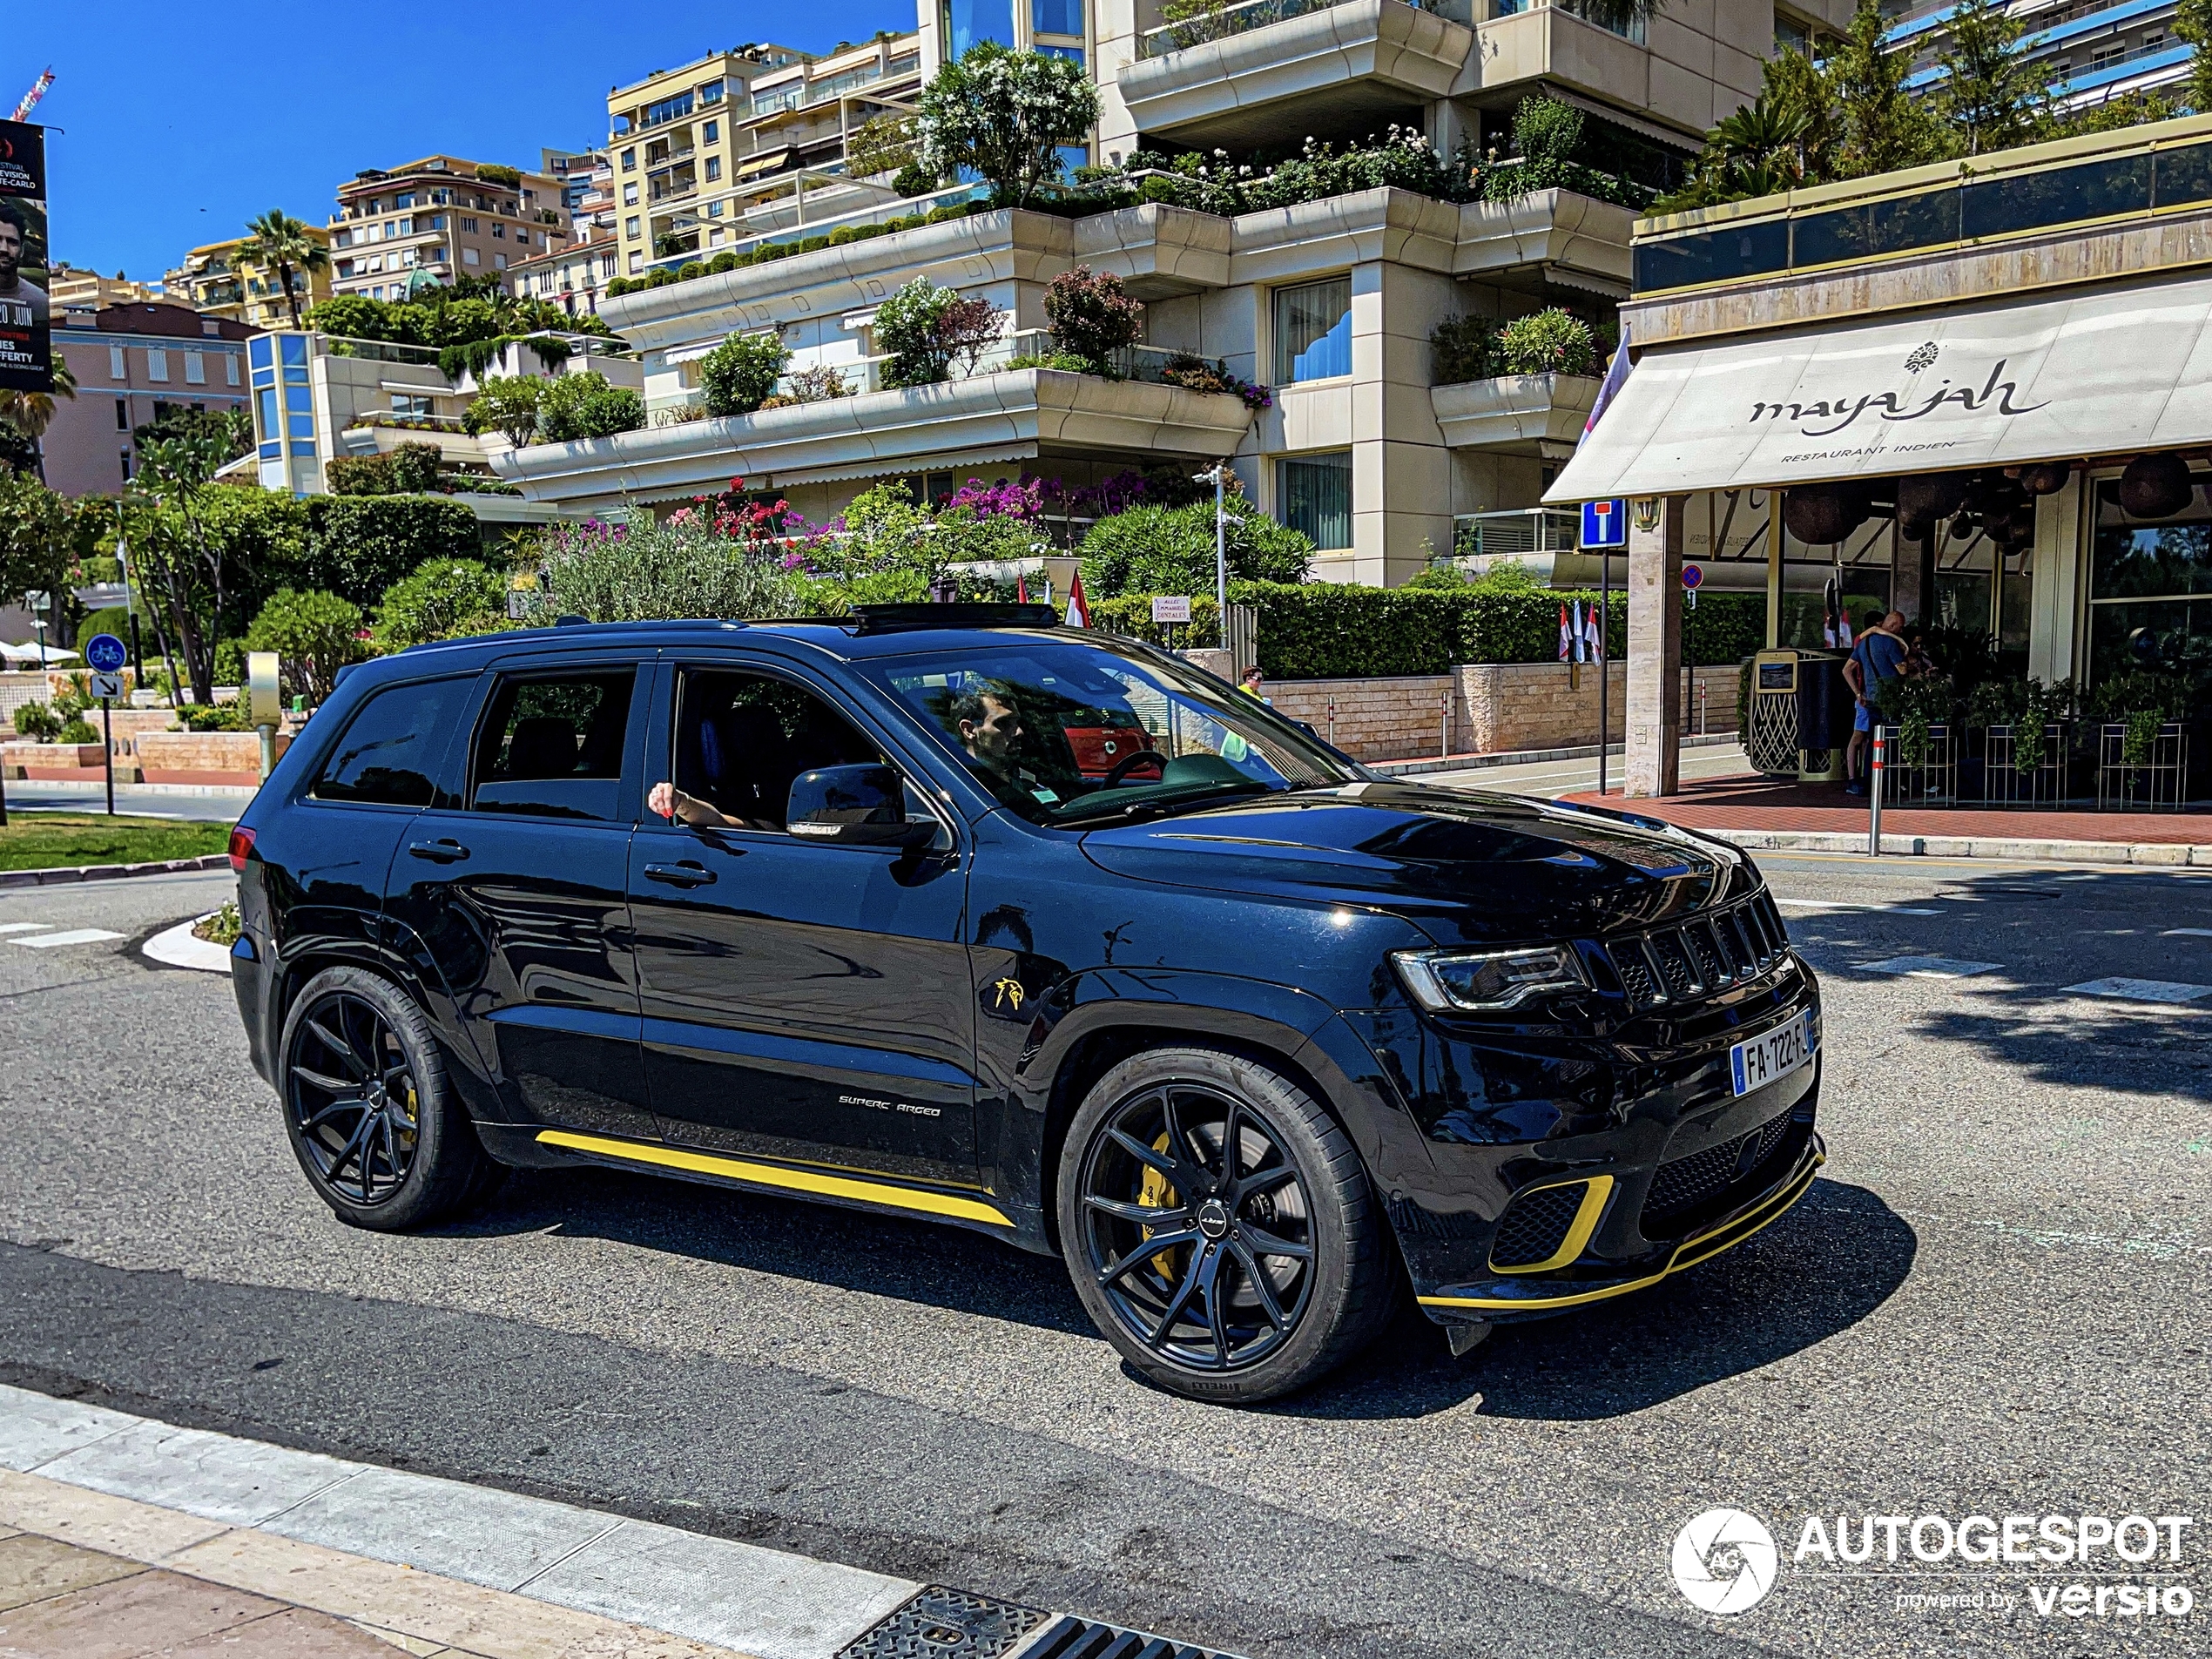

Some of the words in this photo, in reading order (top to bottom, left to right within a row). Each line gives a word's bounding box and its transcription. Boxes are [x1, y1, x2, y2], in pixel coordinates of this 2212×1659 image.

[13, 306, 33, 327] JUIN
[0, 341, 15, 350] ES
[1749, 391, 1909, 436] maya
[1881, 358, 2054, 421] jah
[1780, 445, 1888, 464] RESTAURANT
[1894, 441, 1957, 454] INDIEN
